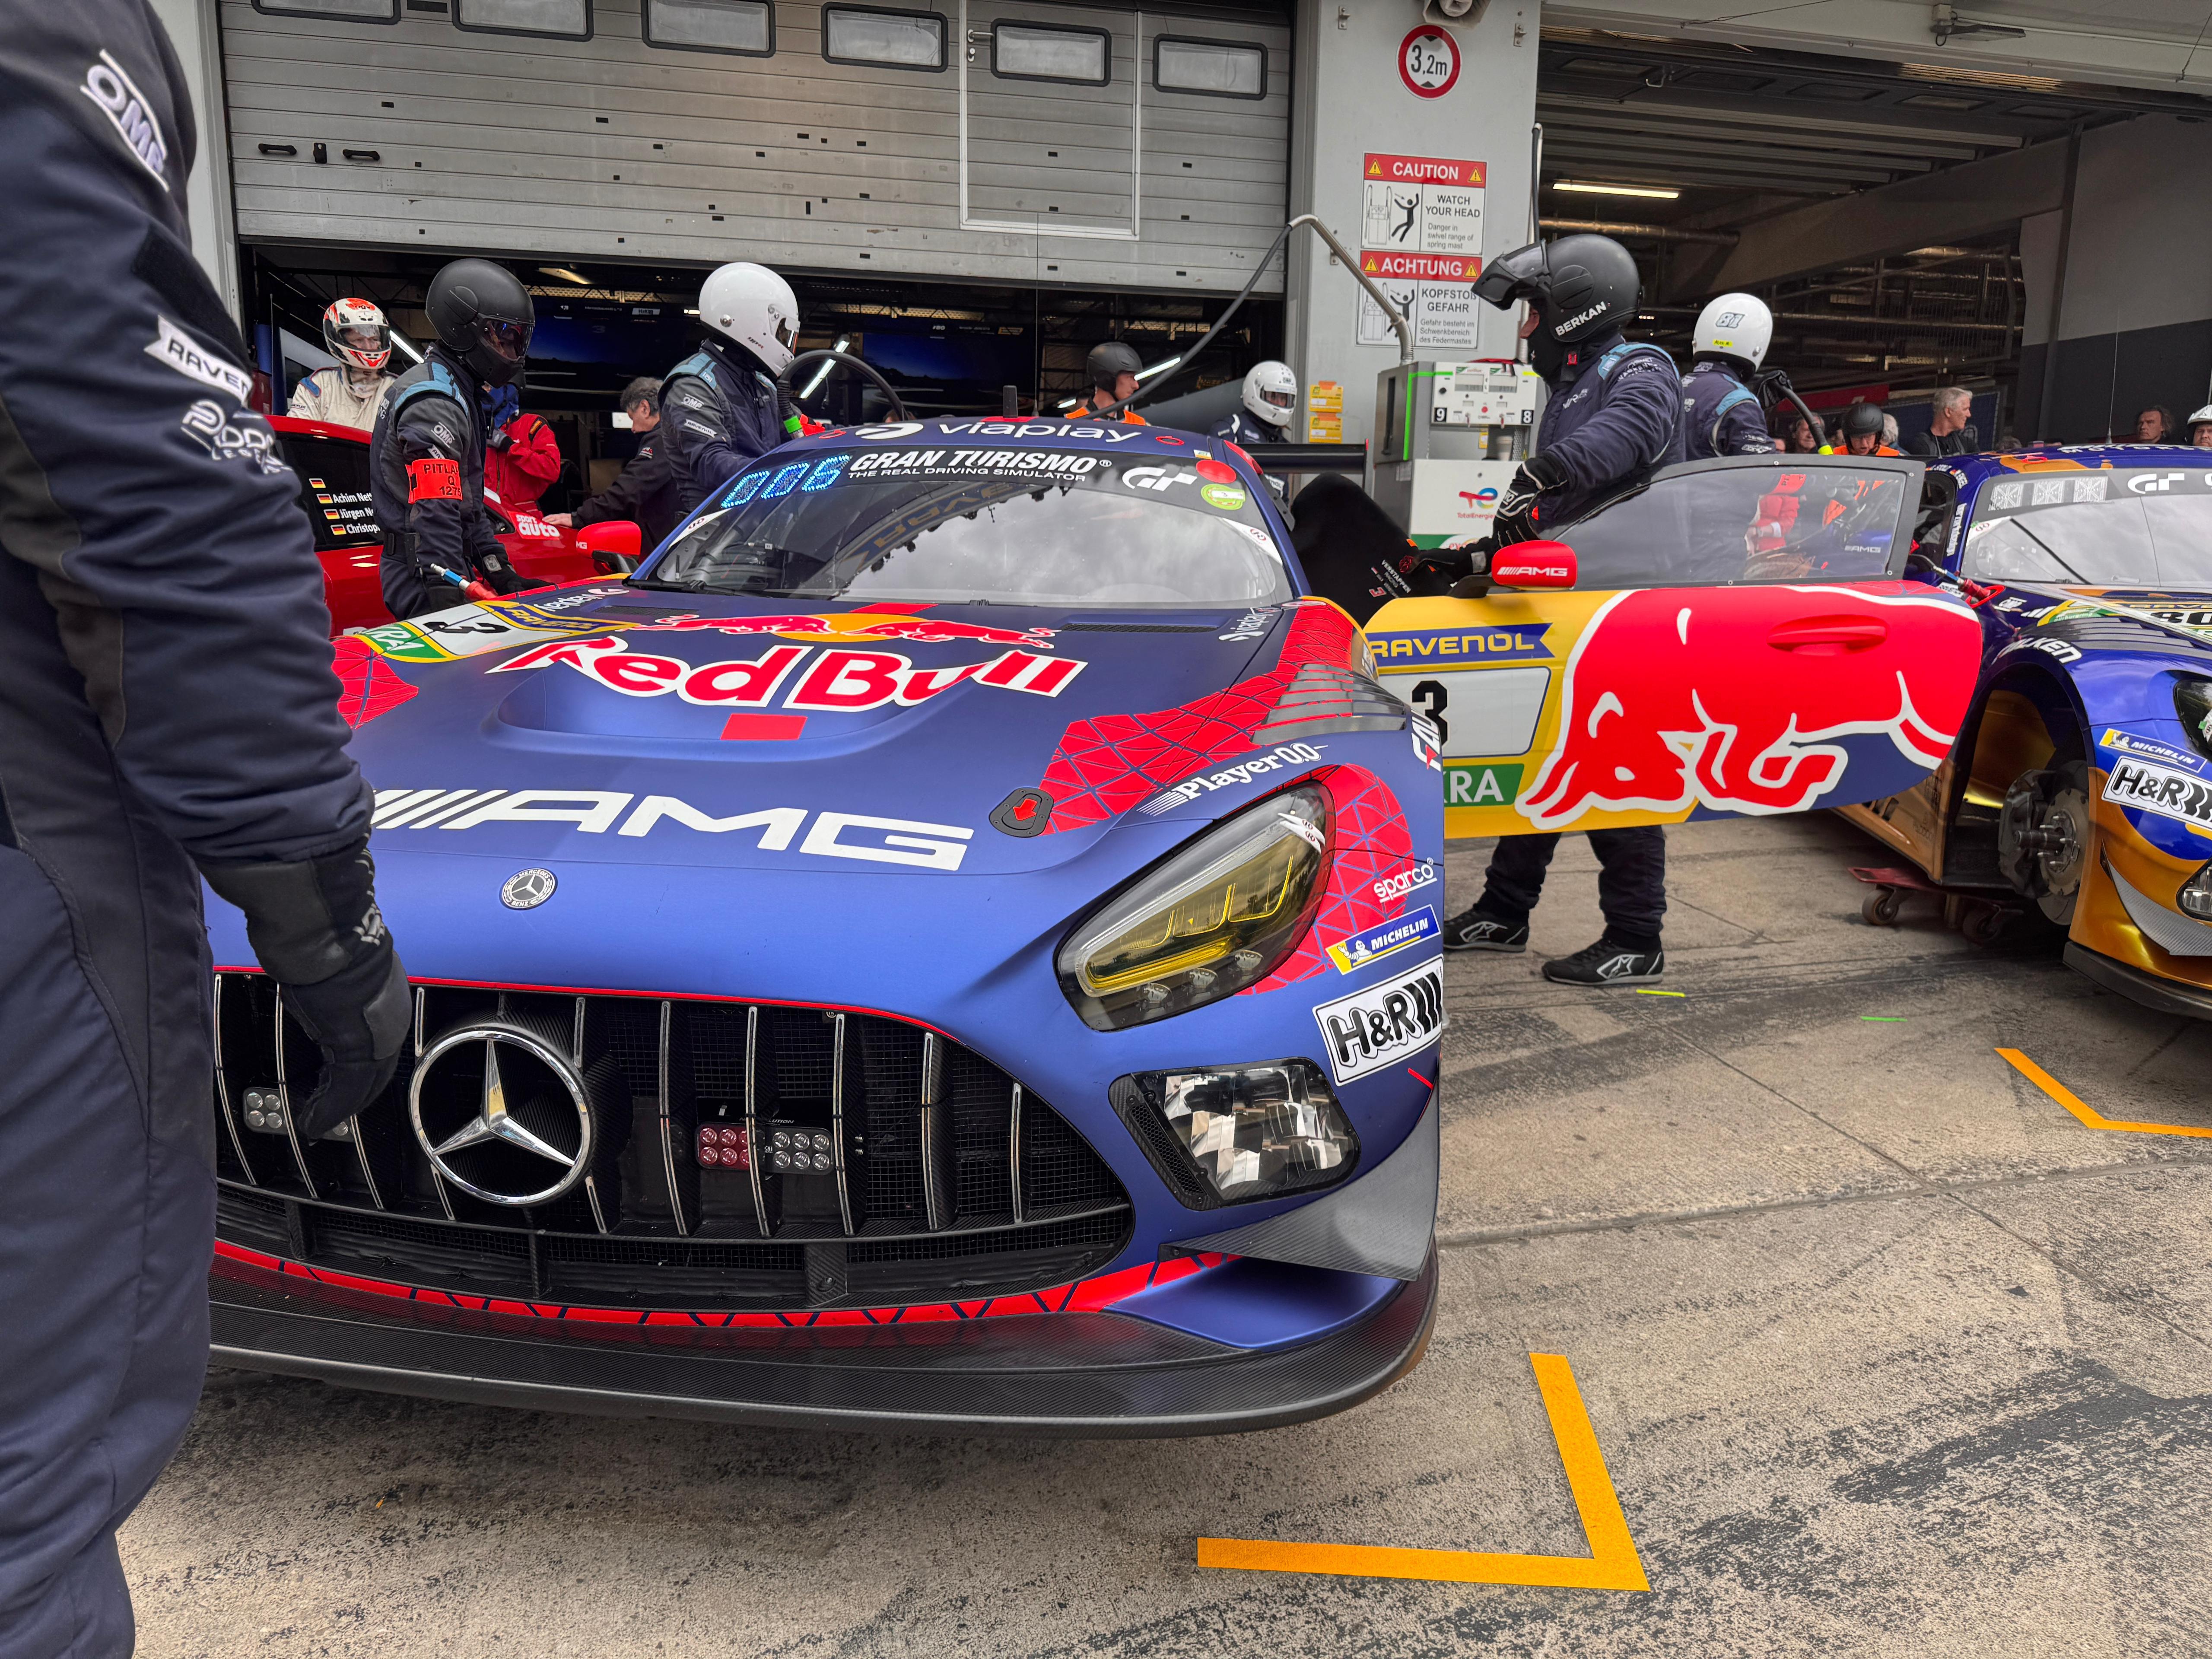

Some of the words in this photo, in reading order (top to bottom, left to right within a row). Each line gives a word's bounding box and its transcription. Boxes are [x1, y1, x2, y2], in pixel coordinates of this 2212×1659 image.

[1411, 45, 1447, 76] 3,2m
[1392, 162, 1459, 180] CAUTION
[1437, 195, 1470, 205] WATCH
[1425, 206, 1452, 216] YOUR
[1454, 208, 1480, 218] HEAD
[1428, 223, 1451, 232] Danger
[1381, 257, 1462, 276] ACHTUNG
[1427, 302, 1469, 312] GEFAHR
[1555, 301, 1607, 337] BERKAN
[1716, 312, 1745, 328] 81
[683, 396, 702, 409] OMP
[1437, 409, 1446, 422] 9
[1523, 410, 1532, 423] 8
[433, 425, 453, 445] OMP
[938, 422, 1142, 442] viaplay
[851, 450, 946, 470] GRAN
[447, 475, 455, 486] Q
[848, 469, 874, 479] THE
[925, 467, 990, 475] DRIVING
[993, 468, 1086, 482] SIMULATOR
[333, 493, 356, 503] Achim
[439, 486, 462, 496] 1275
[340, 509, 364, 520] Jürgen
[516, 514, 537, 524] sport
[518, 522, 560, 537] auto
[1515, 566, 1568, 577] AMG
[1368, 633, 1535, 658] RAVENOL
[485, 636, 814, 708] Red
[783, 646, 1088, 712] Bull
[2131, 741, 2195, 765] MICHELIN
[1444, 768, 1504, 804] RA
[2112, 764, 2187, 806] H&R
[440, 789, 974, 871] AMG
[1373, 864, 1434, 899] sparco
[1371, 917, 1429, 950] MICHELIN
[1329, 989, 1416, 1063] H&R
